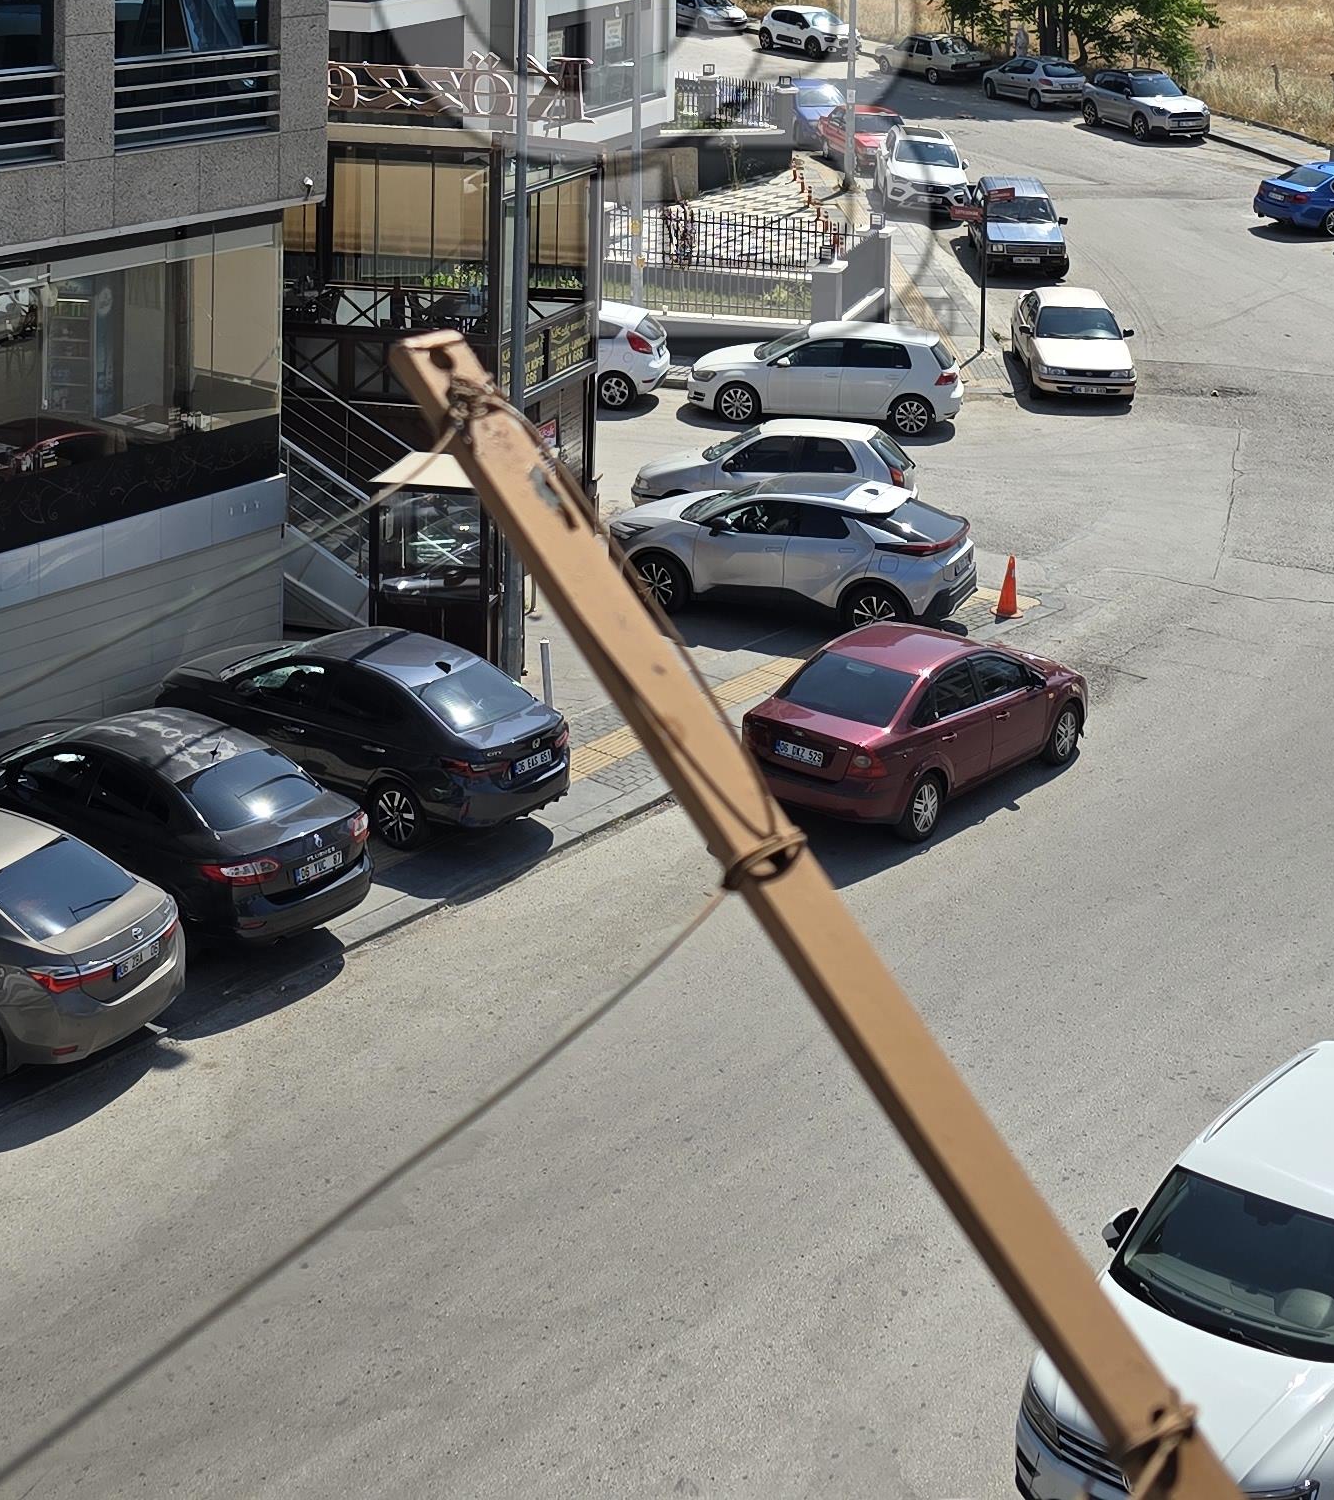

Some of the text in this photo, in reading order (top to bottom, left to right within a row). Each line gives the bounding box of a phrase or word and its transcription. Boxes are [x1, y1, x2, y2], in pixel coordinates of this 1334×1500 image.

[779, 742, 789, 753] 06
[519, 761, 526, 773] 06
[301, 866, 310, 879] 06
